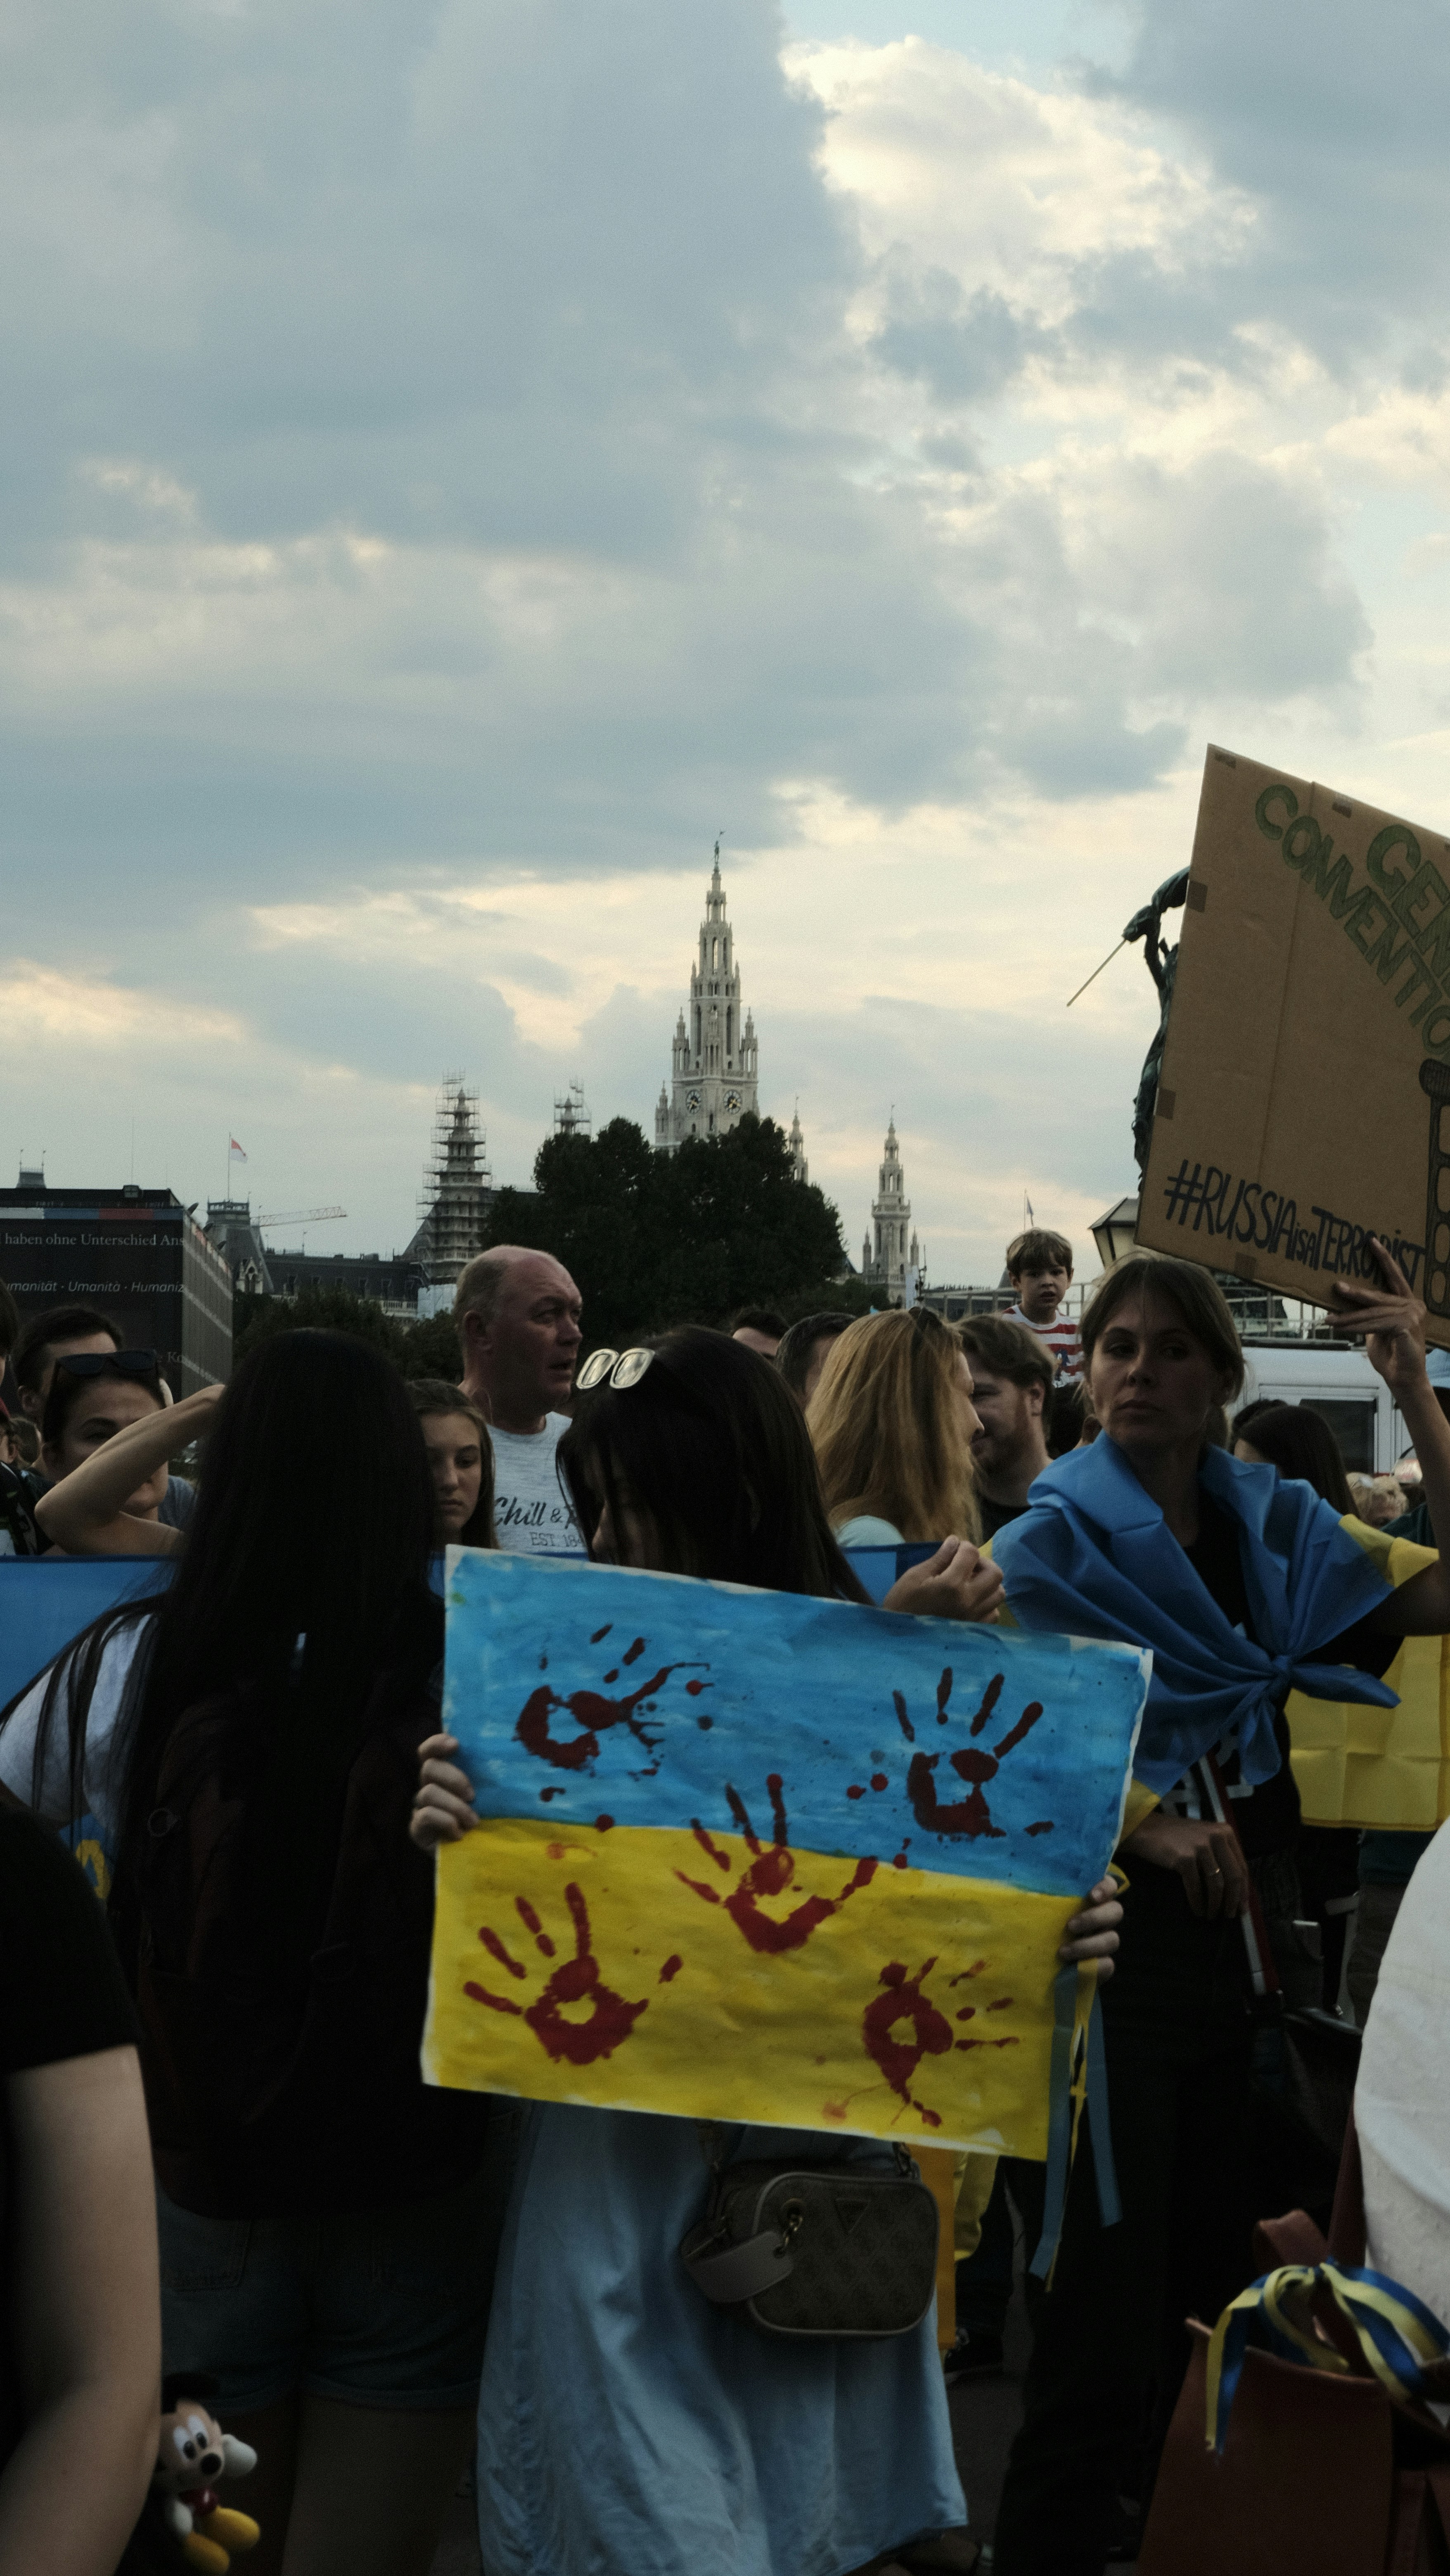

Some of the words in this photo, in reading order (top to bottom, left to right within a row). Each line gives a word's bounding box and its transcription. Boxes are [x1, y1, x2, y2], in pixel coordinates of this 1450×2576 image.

[1255, 784, 1450, 1061] CONVENTIO
[1367, 824, 1450, 997] GEN
[5, 1233, 42, 1244] haben
[46, 1233, 76, 1245] ohne
[81, 1233, 156, 1245] Unterschied
[495, 1496, 546, 1526] Chill
[550, 1508, 562, 1522] &
